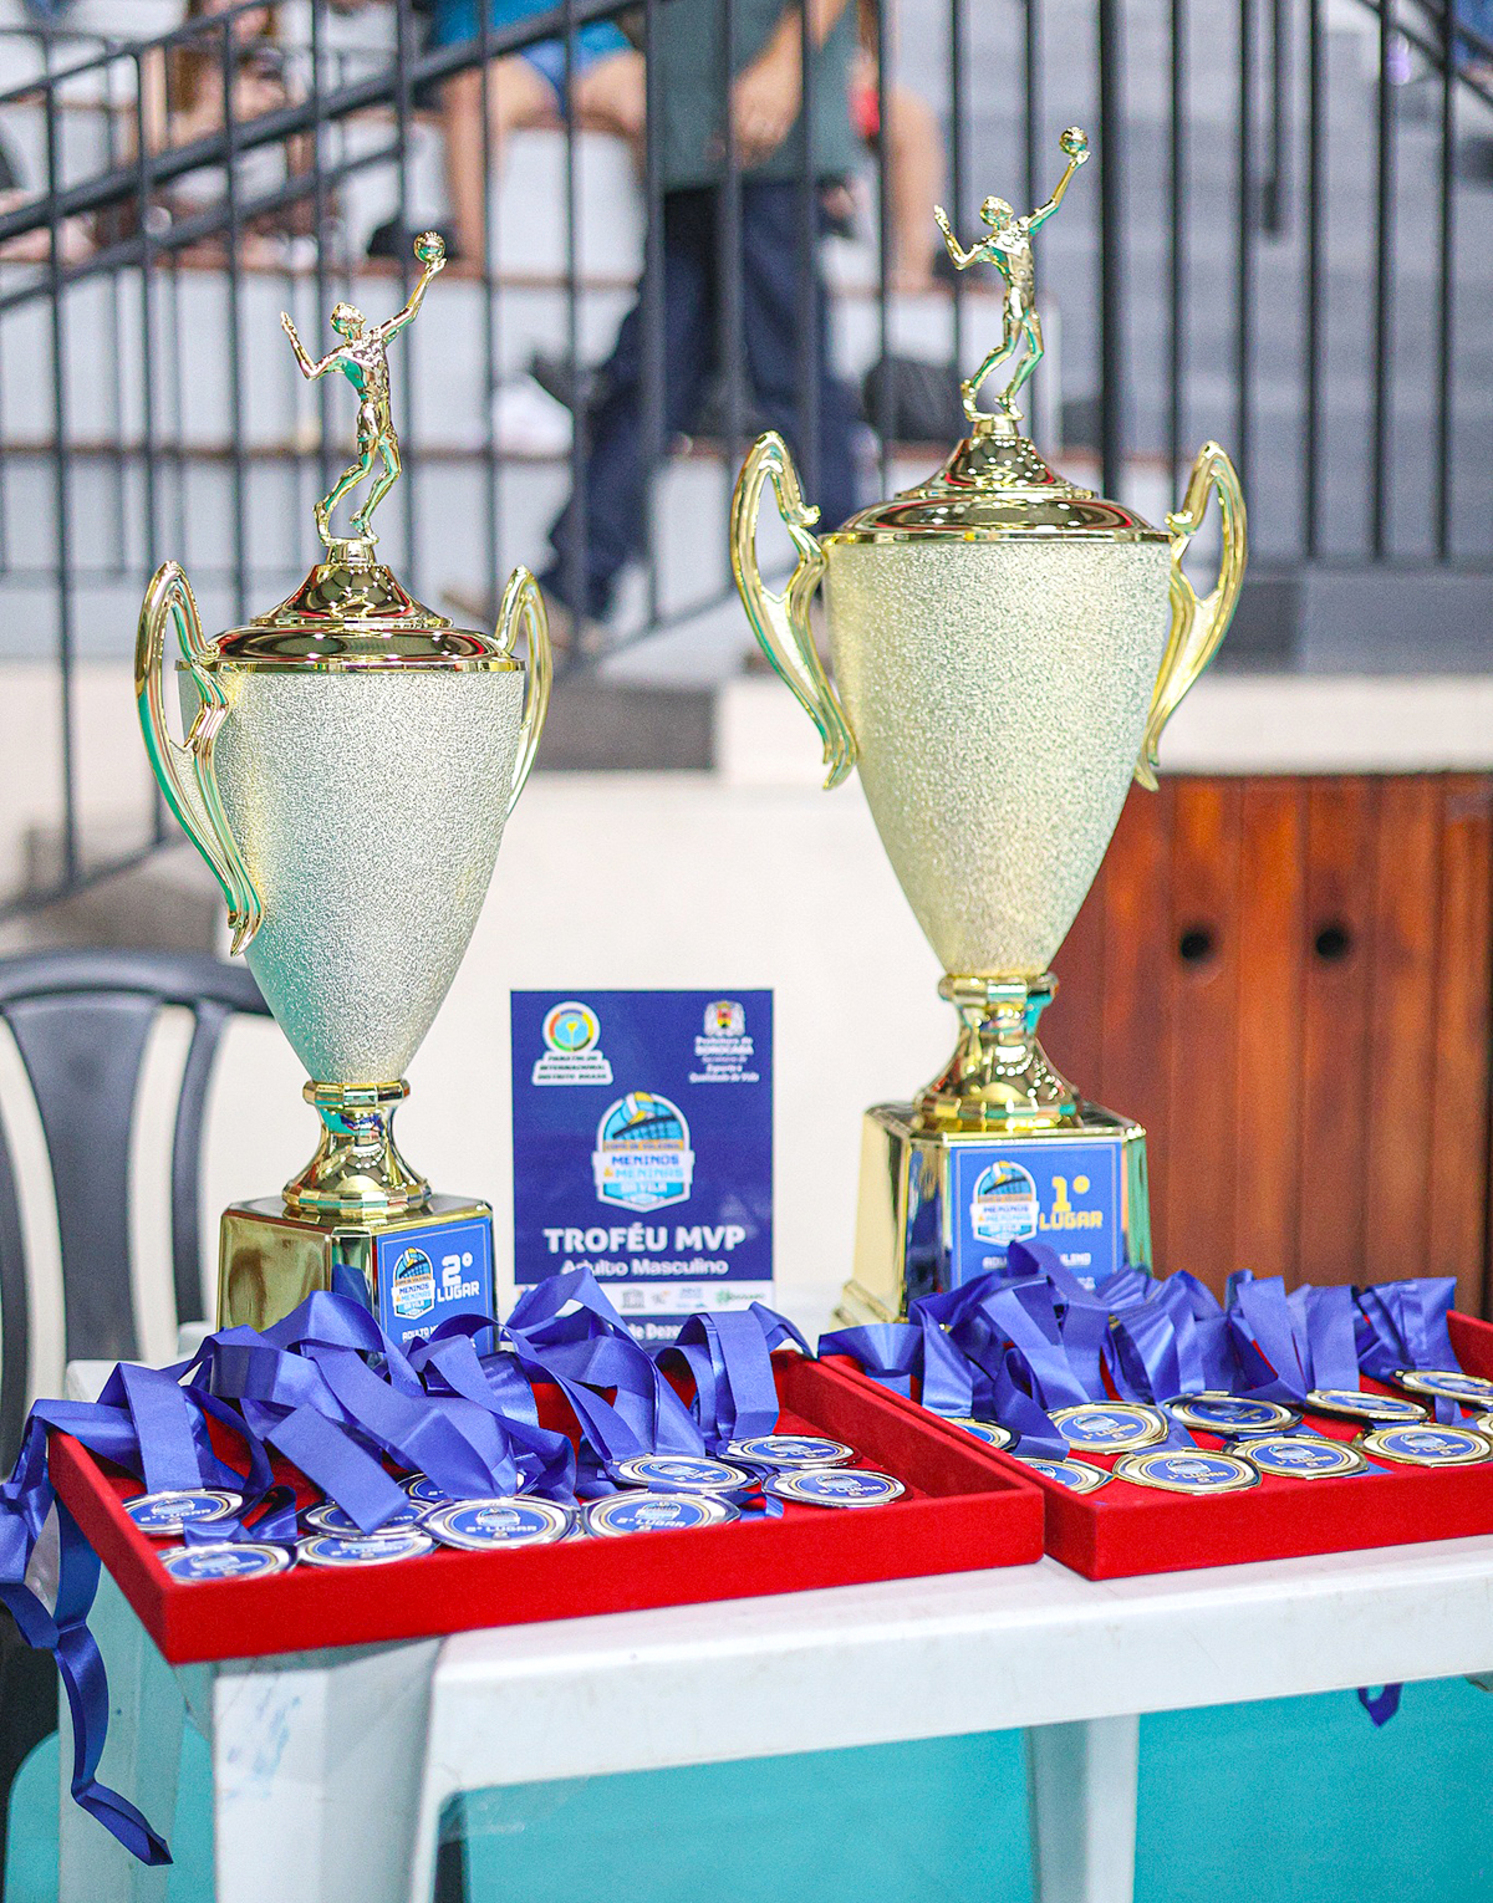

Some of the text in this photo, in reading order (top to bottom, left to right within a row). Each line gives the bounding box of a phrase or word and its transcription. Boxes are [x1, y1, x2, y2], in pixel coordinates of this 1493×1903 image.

[611, 1155, 679, 1165] MENINOS
[615, 1167, 683, 1177] MENINAS
[1039, 1210, 1103, 1231] LUGAR
[543, 1222, 747, 1253] TROFÉU MVP
[631, 1257, 729, 1276] Masculino
[437, 1280, 480, 1303] LUGAR
[485, 1525, 538, 1533] LUGAR
[636, 1519, 687, 1528] LUGAR
